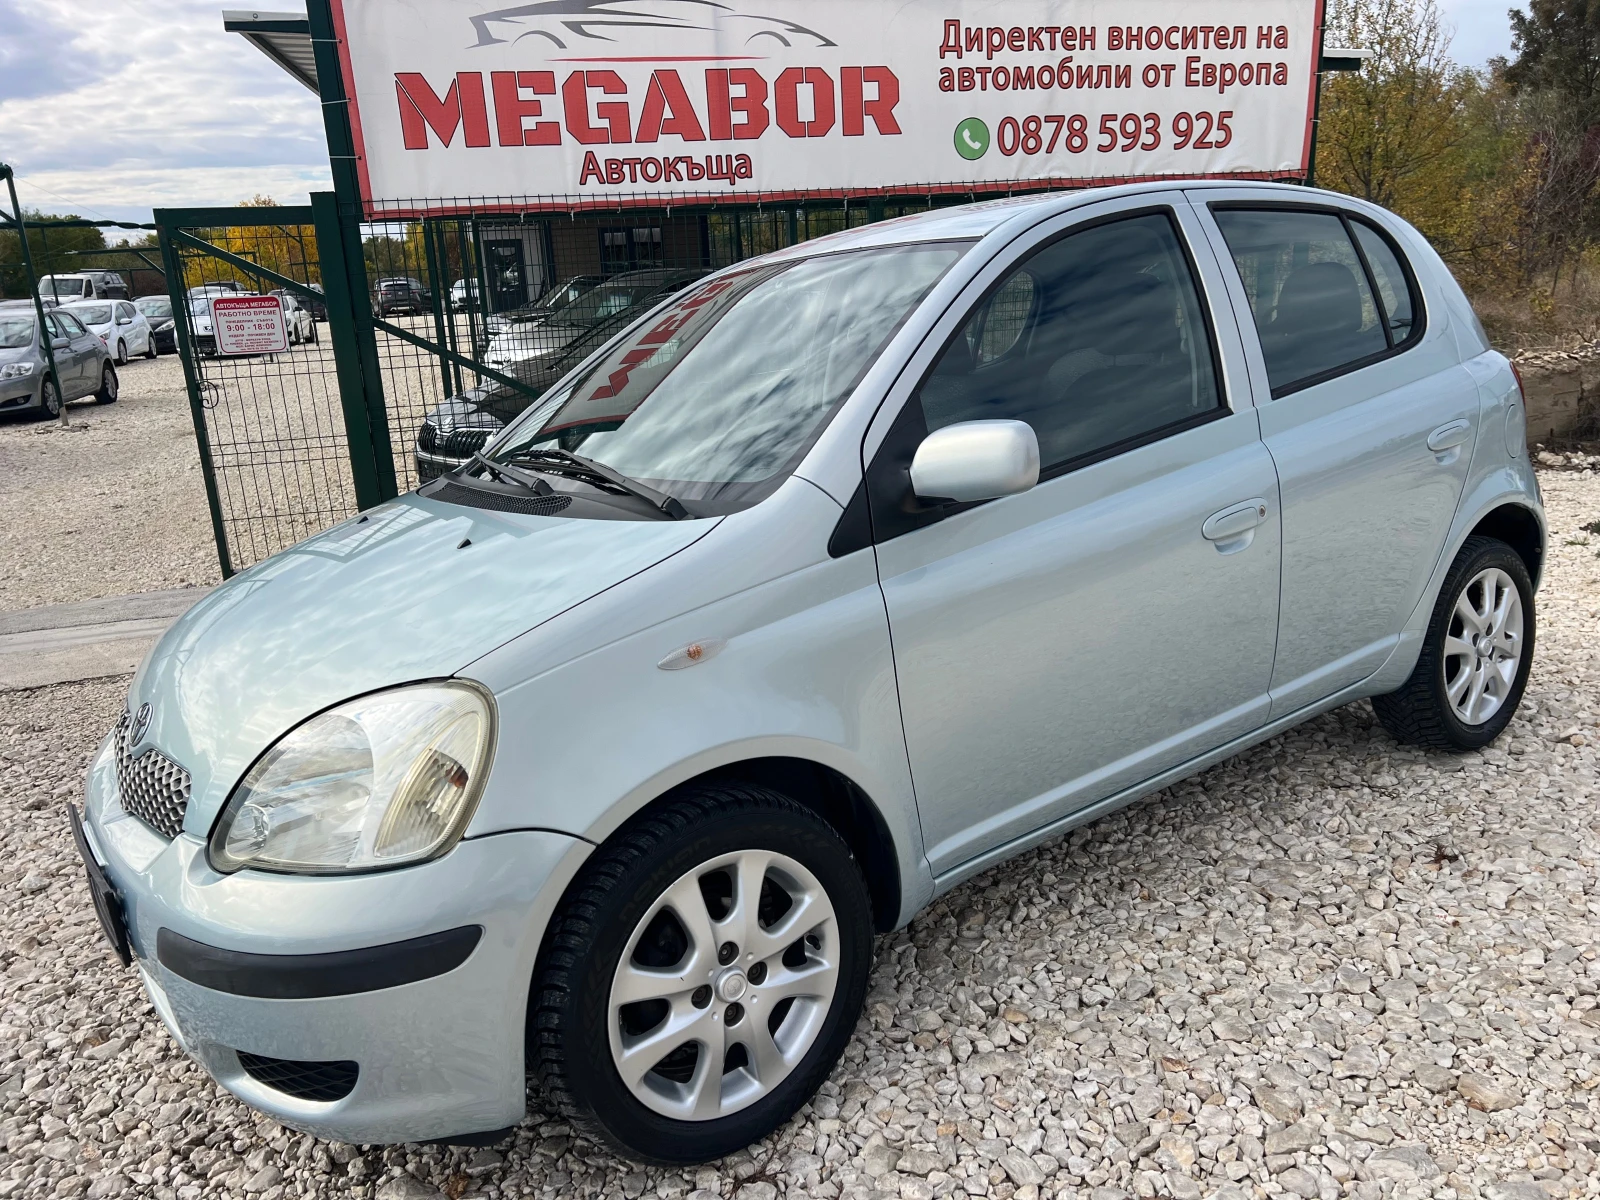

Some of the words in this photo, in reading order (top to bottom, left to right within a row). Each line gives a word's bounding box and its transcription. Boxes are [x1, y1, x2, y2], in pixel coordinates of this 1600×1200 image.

[939, 18, 1097, 60] Директен
[1107, 25, 1247, 51] вносител
[1256, 25, 1289, 50] на
[938, 56, 1132, 92] автомобили
[1141, 63, 1177, 88] от
[1185, 56, 1288, 94] Европа
[394, 65, 902, 150] MEGABOR
[998, 114, 1089, 157] 0878
[1097, 112, 1161, 153] 593
[1172, 111, 1234, 150] 925
[579, 150, 753, 186] Автокъща
[226, 324, 245, 332] 9:00
[252, 322, 275, 331] 18:00
